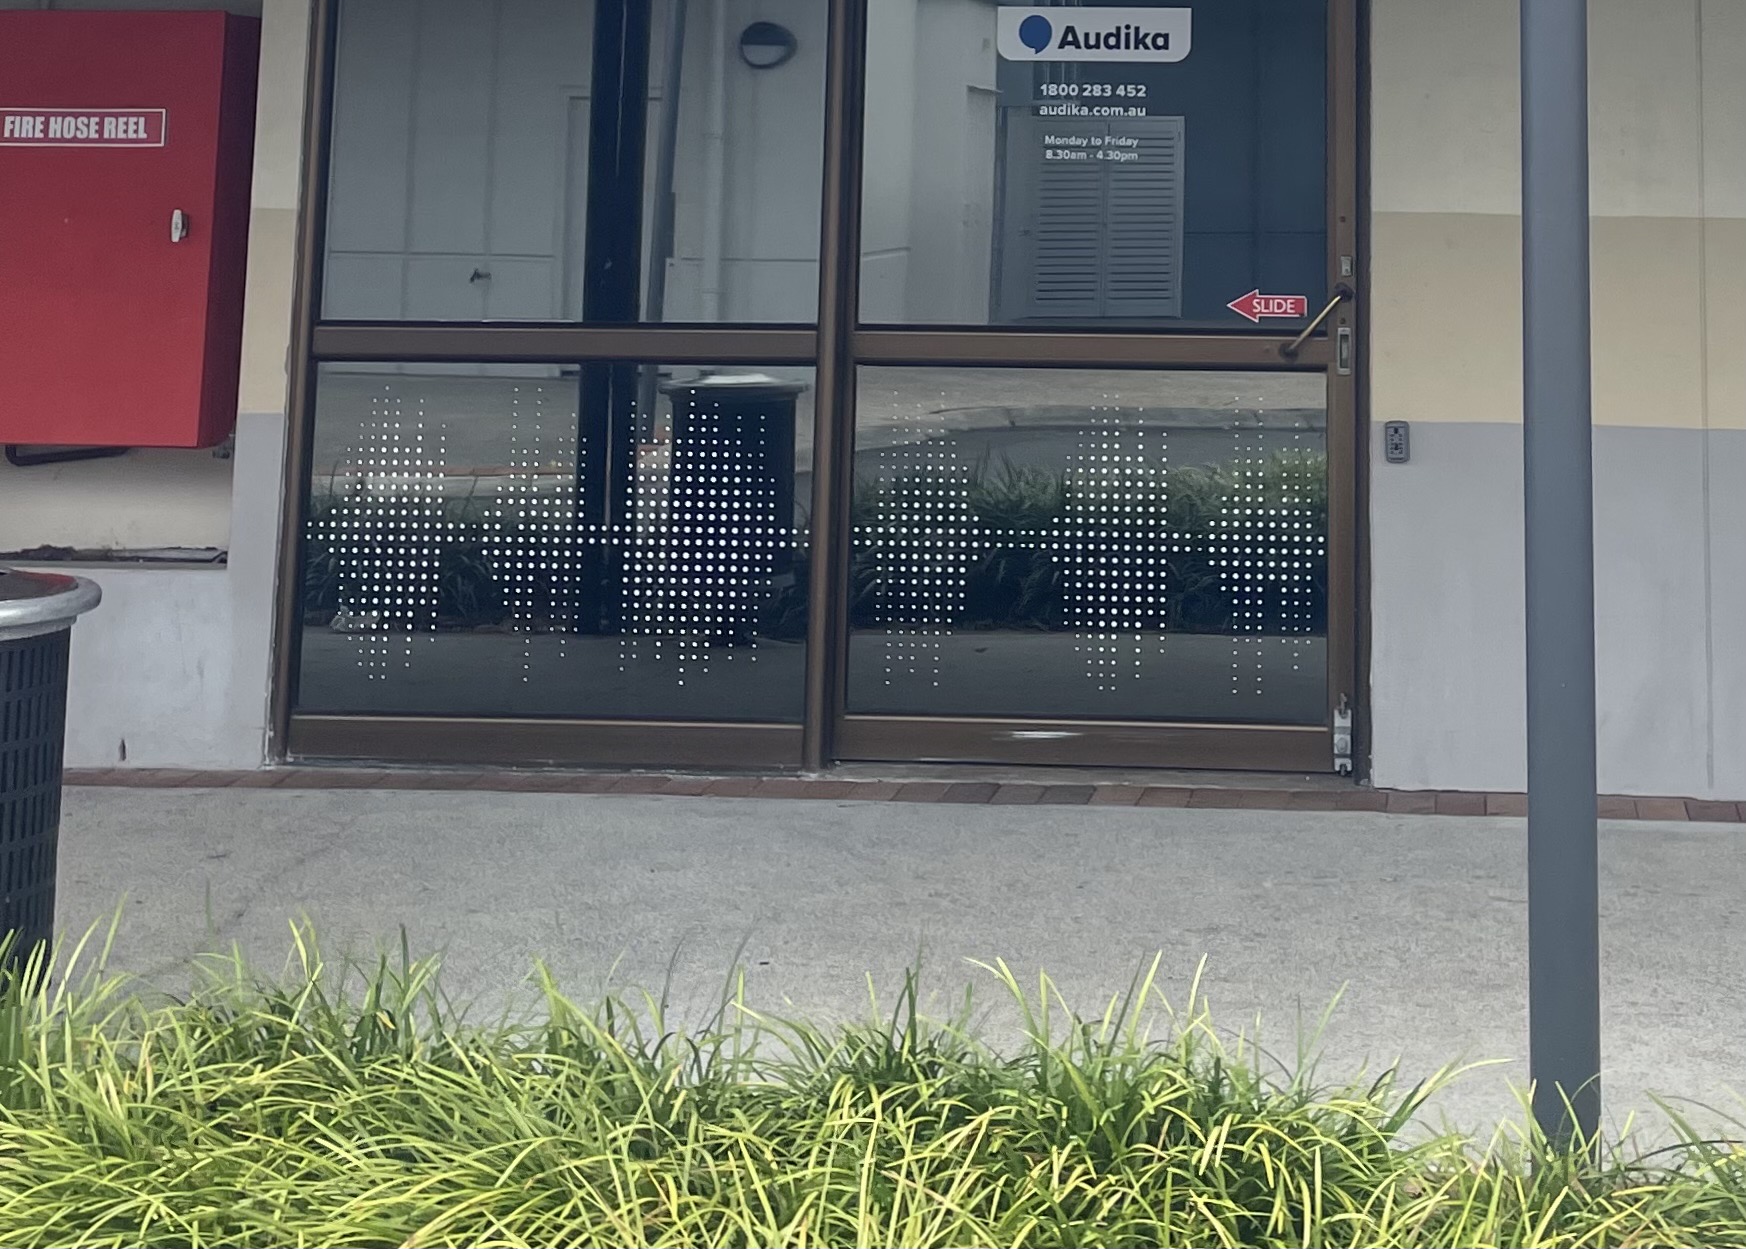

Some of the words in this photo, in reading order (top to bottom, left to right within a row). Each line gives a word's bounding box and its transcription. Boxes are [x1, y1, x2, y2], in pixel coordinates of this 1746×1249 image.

[1057, 24, 1170, 51] Audika
[1039, 84, 1079, 96] 1800
[1082, 84, 1112, 96] 283
[1115, 85, 1147, 97] 452
[1039, 104, 1147, 117] audika.com.au
[3, 116, 46, 139] FIRE
[48, 116, 100, 139] HOSE
[103, 116, 148, 139] REEL
[1044, 135, 1088, 147] Monday
[1091, 136, 1103, 146] to
[1105, 136, 1139, 148] Friday
[1045, 149, 1088, 160] 8.30am
[1096, 150, 1139, 162] 4.30pm
[1252, 299, 1296, 313] SLIDE
